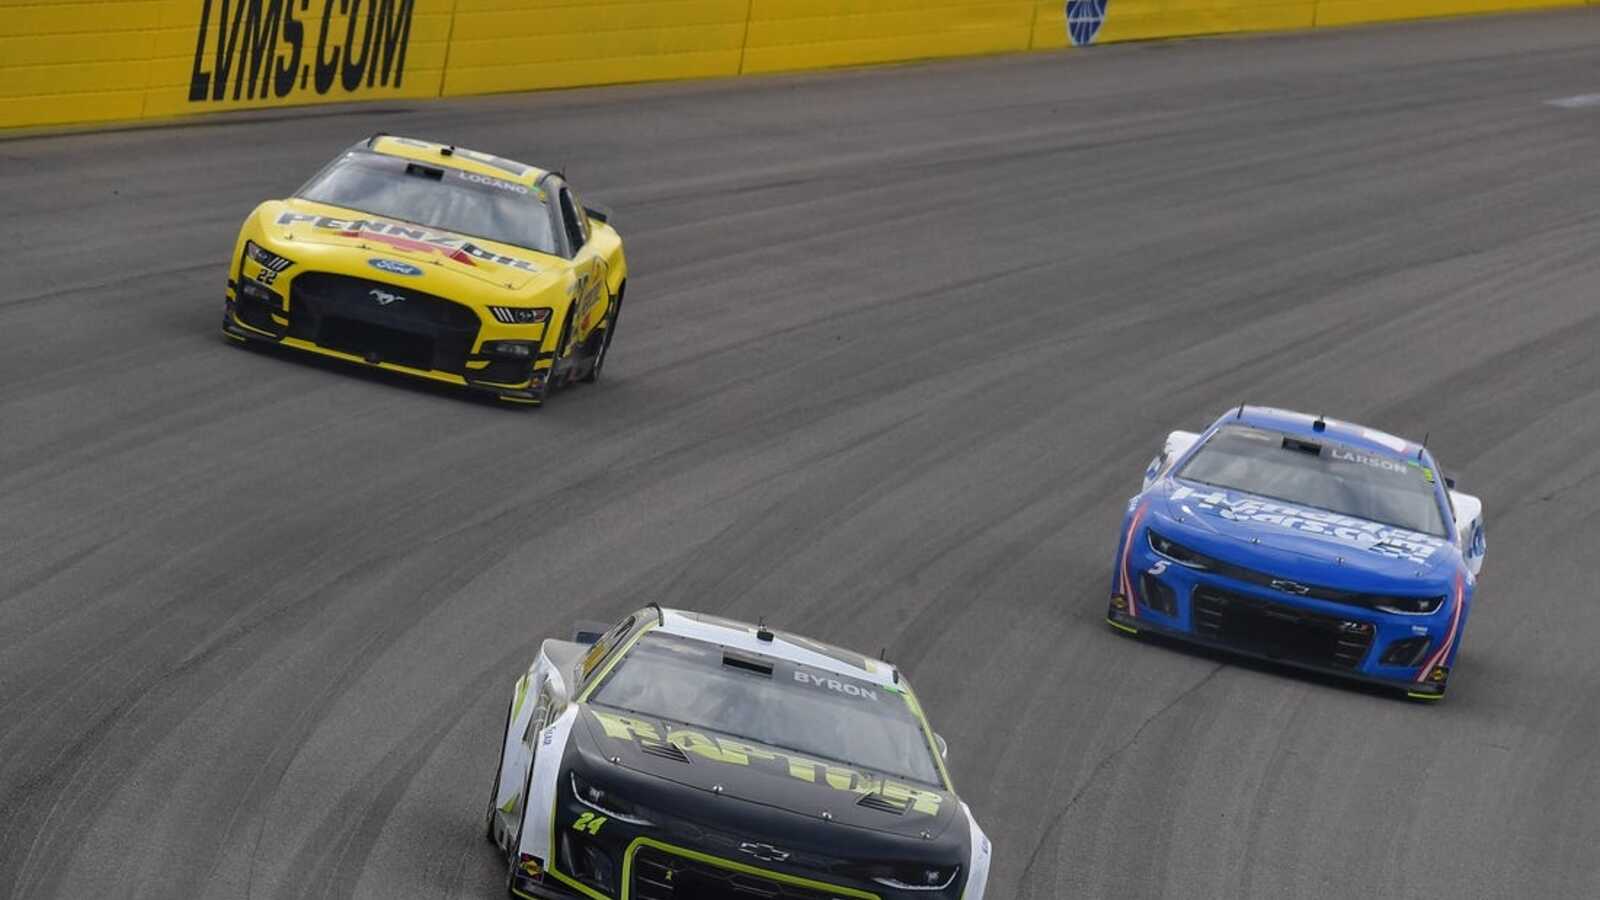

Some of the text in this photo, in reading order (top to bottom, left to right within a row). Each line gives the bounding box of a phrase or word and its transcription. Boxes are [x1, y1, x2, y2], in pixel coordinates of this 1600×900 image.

[188, 0, 414, 101] LVMS.COM
[459, 171, 529, 195] LOGANO
[256, 268, 278, 285] 22
[374, 259, 417, 274] Ford
[1331, 449, 1408, 475] LARSON
[1147, 560, 1172, 575] 5
[793, 671, 878, 700] BYRON
[573, 811, 607, 835] 24
